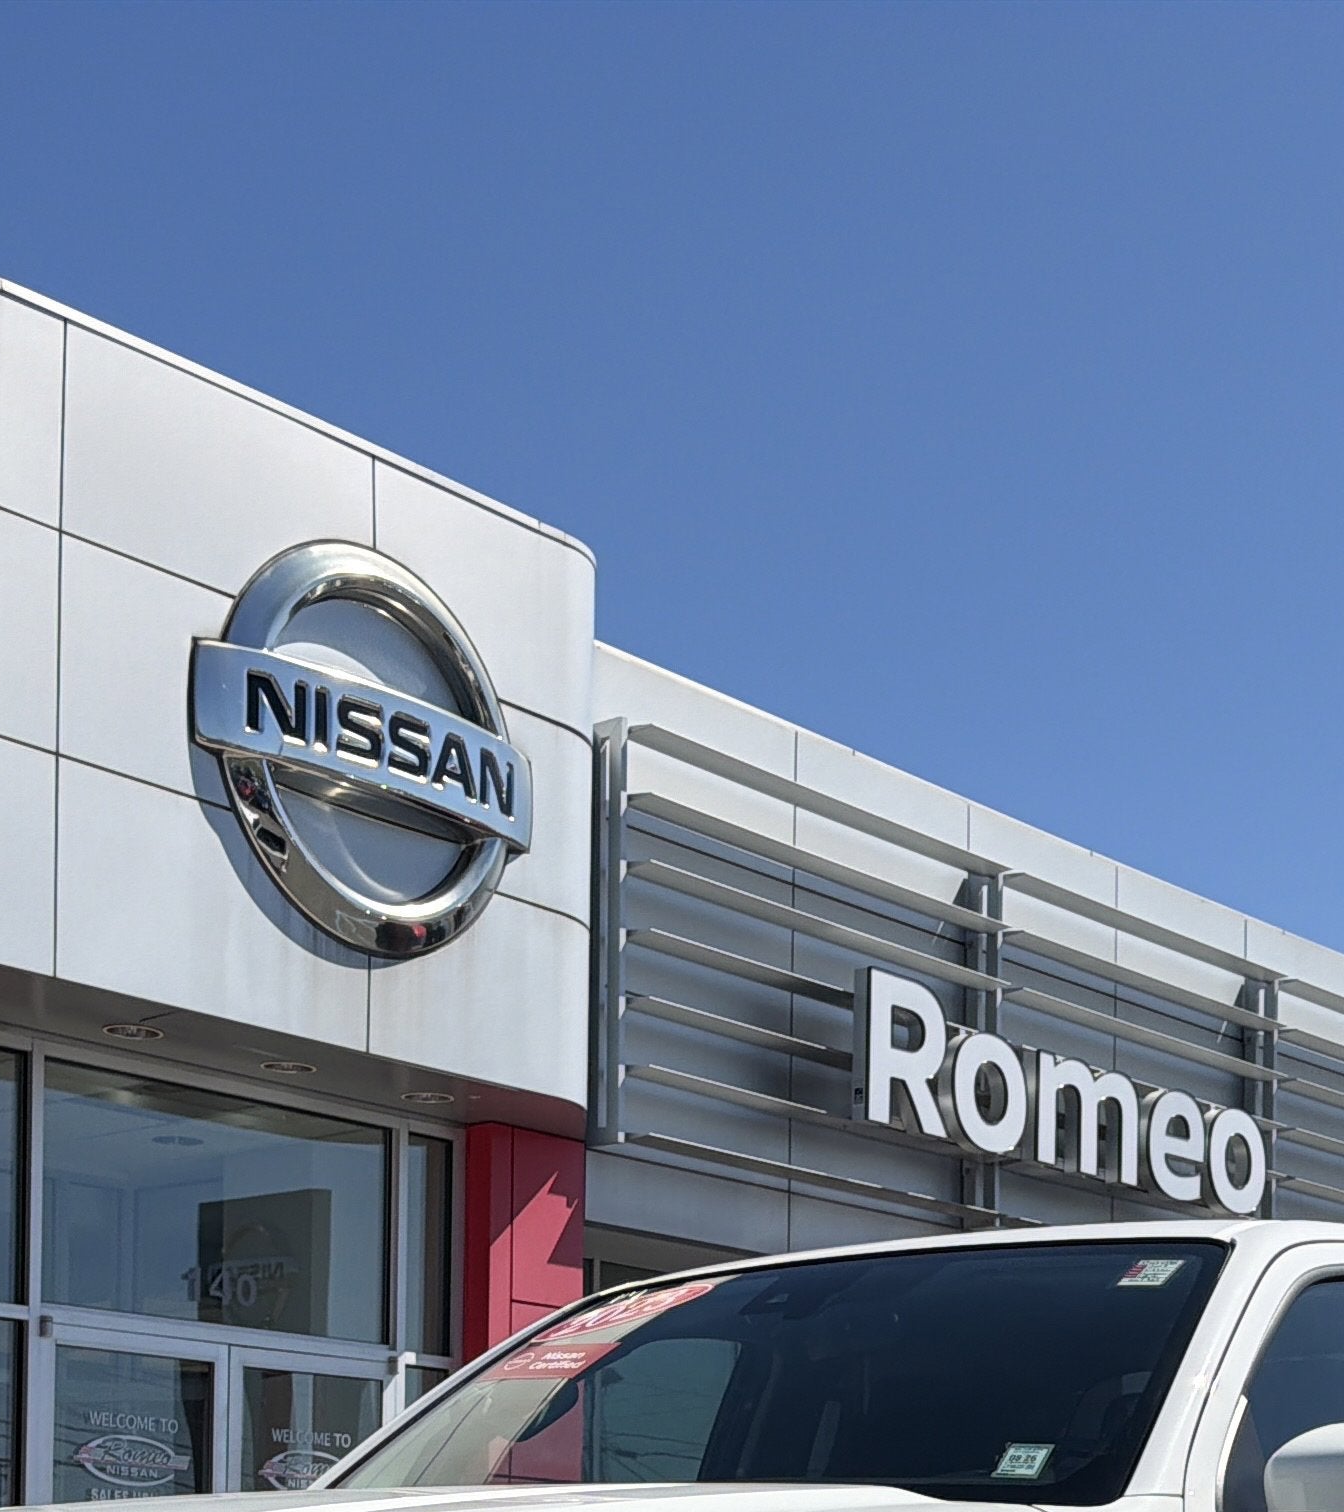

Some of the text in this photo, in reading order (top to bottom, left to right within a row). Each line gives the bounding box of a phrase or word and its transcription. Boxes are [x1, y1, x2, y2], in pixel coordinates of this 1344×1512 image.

[242, 668, 518, 822] NISSAN
[864, 964, 1268, 1215] Romeo
[181, 1266, 256, 1307] 140
[540, 1352, 586, 1361] Nissan
[89, 1410, 179, 1434] WELCOME TO
[272, 1428, 352, 1448] WELCOME TO
[105, 1464, 158, 1478] NISSAN
